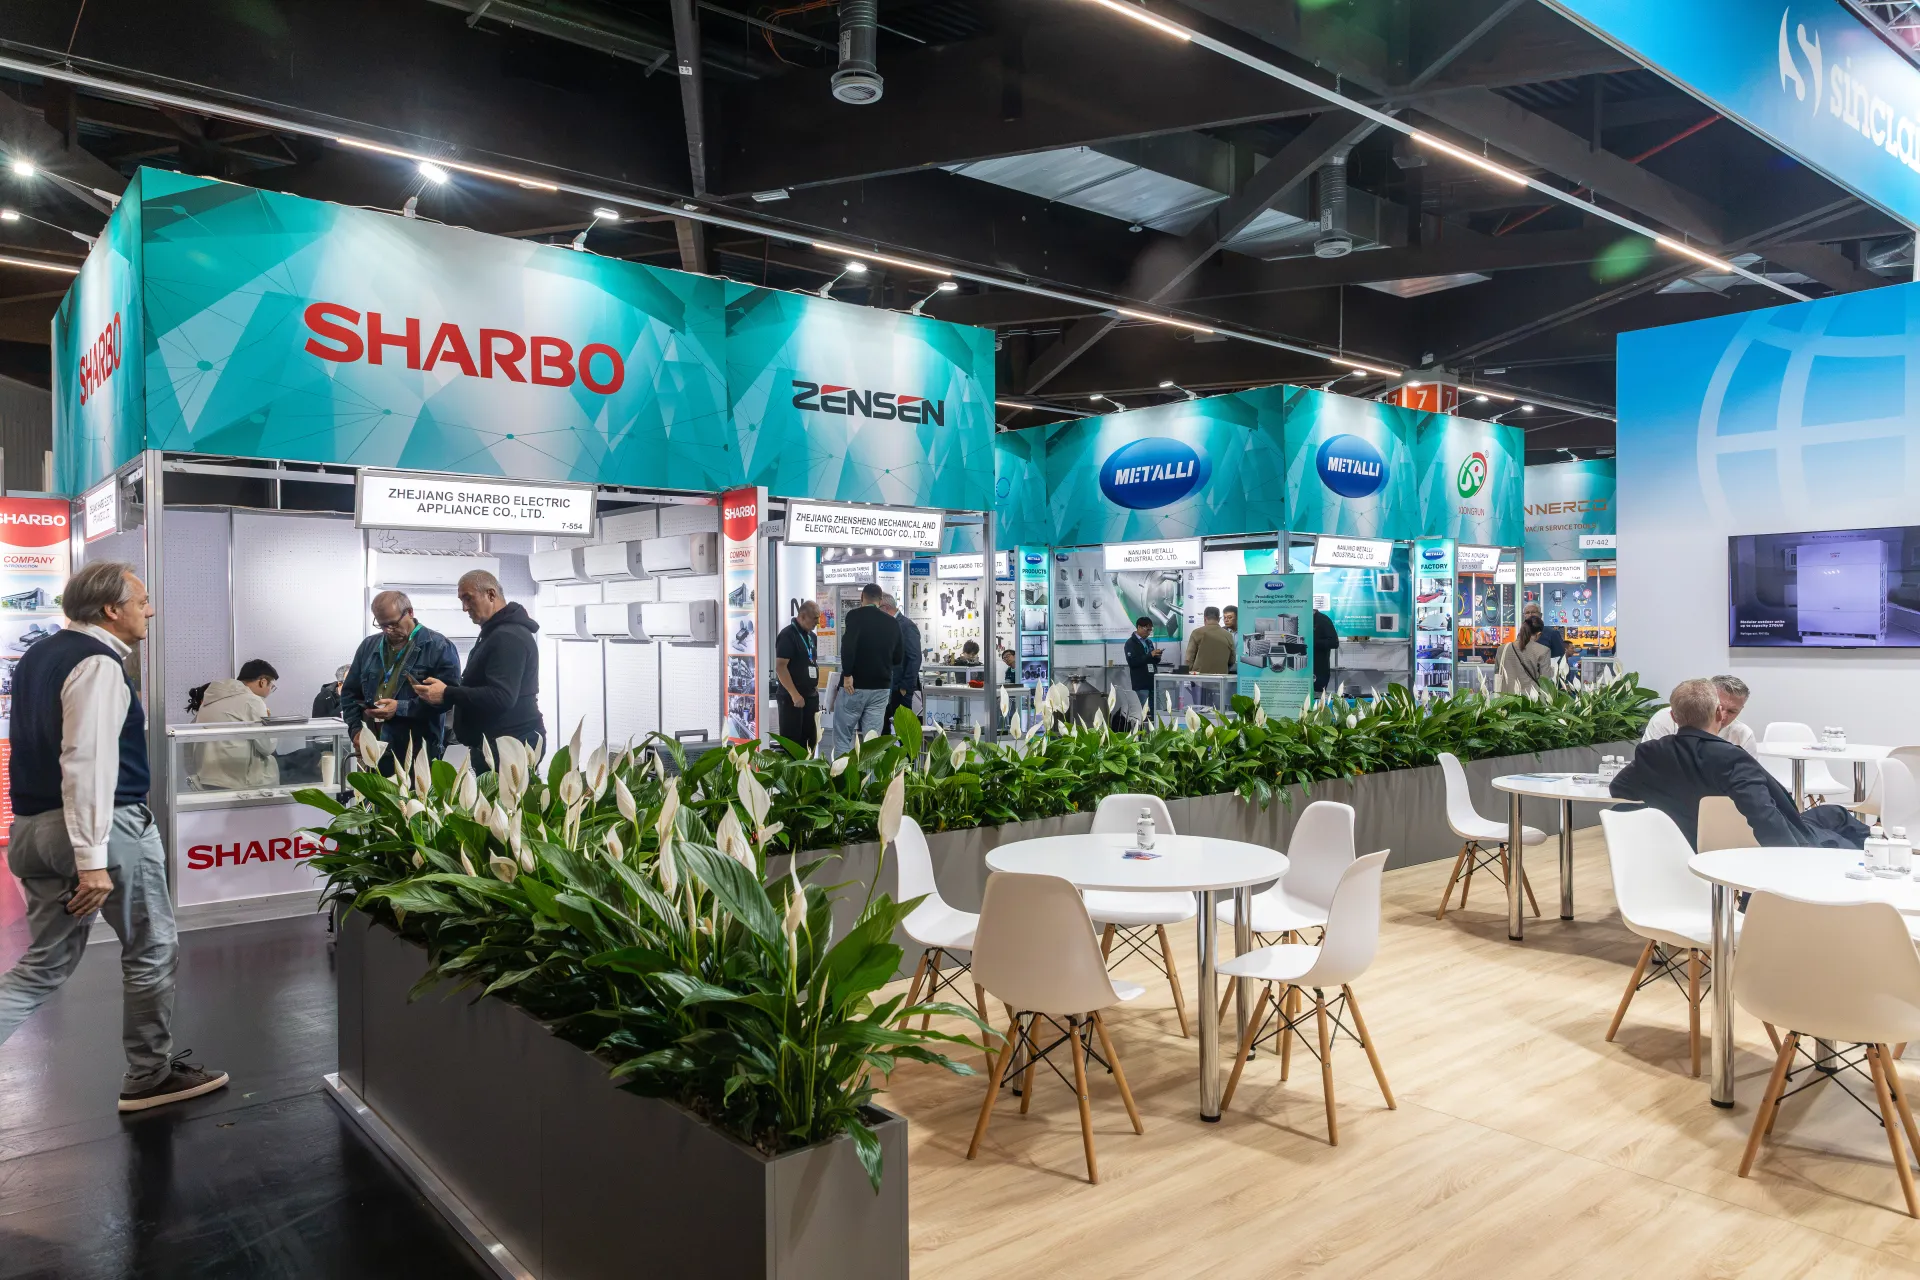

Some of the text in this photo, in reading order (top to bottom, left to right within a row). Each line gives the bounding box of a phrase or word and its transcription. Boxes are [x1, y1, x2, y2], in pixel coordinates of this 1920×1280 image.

[303, 301, 625, 395] SHARBO
[79, 311, 122, 406] SHARBO
[791, 380, 945, 427] ZENSEN
[1416, 390, 1428, 409] 7
[1446, 391, 1452, 409] 7
[1114, 460, 1195, 486] METALLI
[1326, 454, 1381, 477] METALLI
[388, 487, 571, 508] ZHEJIANG SHARBO ELECTRIC
[417, 502, 546, 519] APPLIANCE CO., LTD.
[724, 504, 756, 520] SHARBO
[561, 522, 583, 530] 7-554
[796, 512, 937, 530] ZHEJIANG ZHENSHENG MECHANICAL AND
[1545, 524, 1573, 532] SERVICE
[804, 523, 927, 539] ELECTRICAL TECHNOLOGY CO., LTD.
[3, 555, 55, 564] COMPANY
[730, 549, 752, 559] COMPANY
[1123, 555, 1154, 563] INDUSTRIAL
[1151, 547, 1174, 555] METALLI
